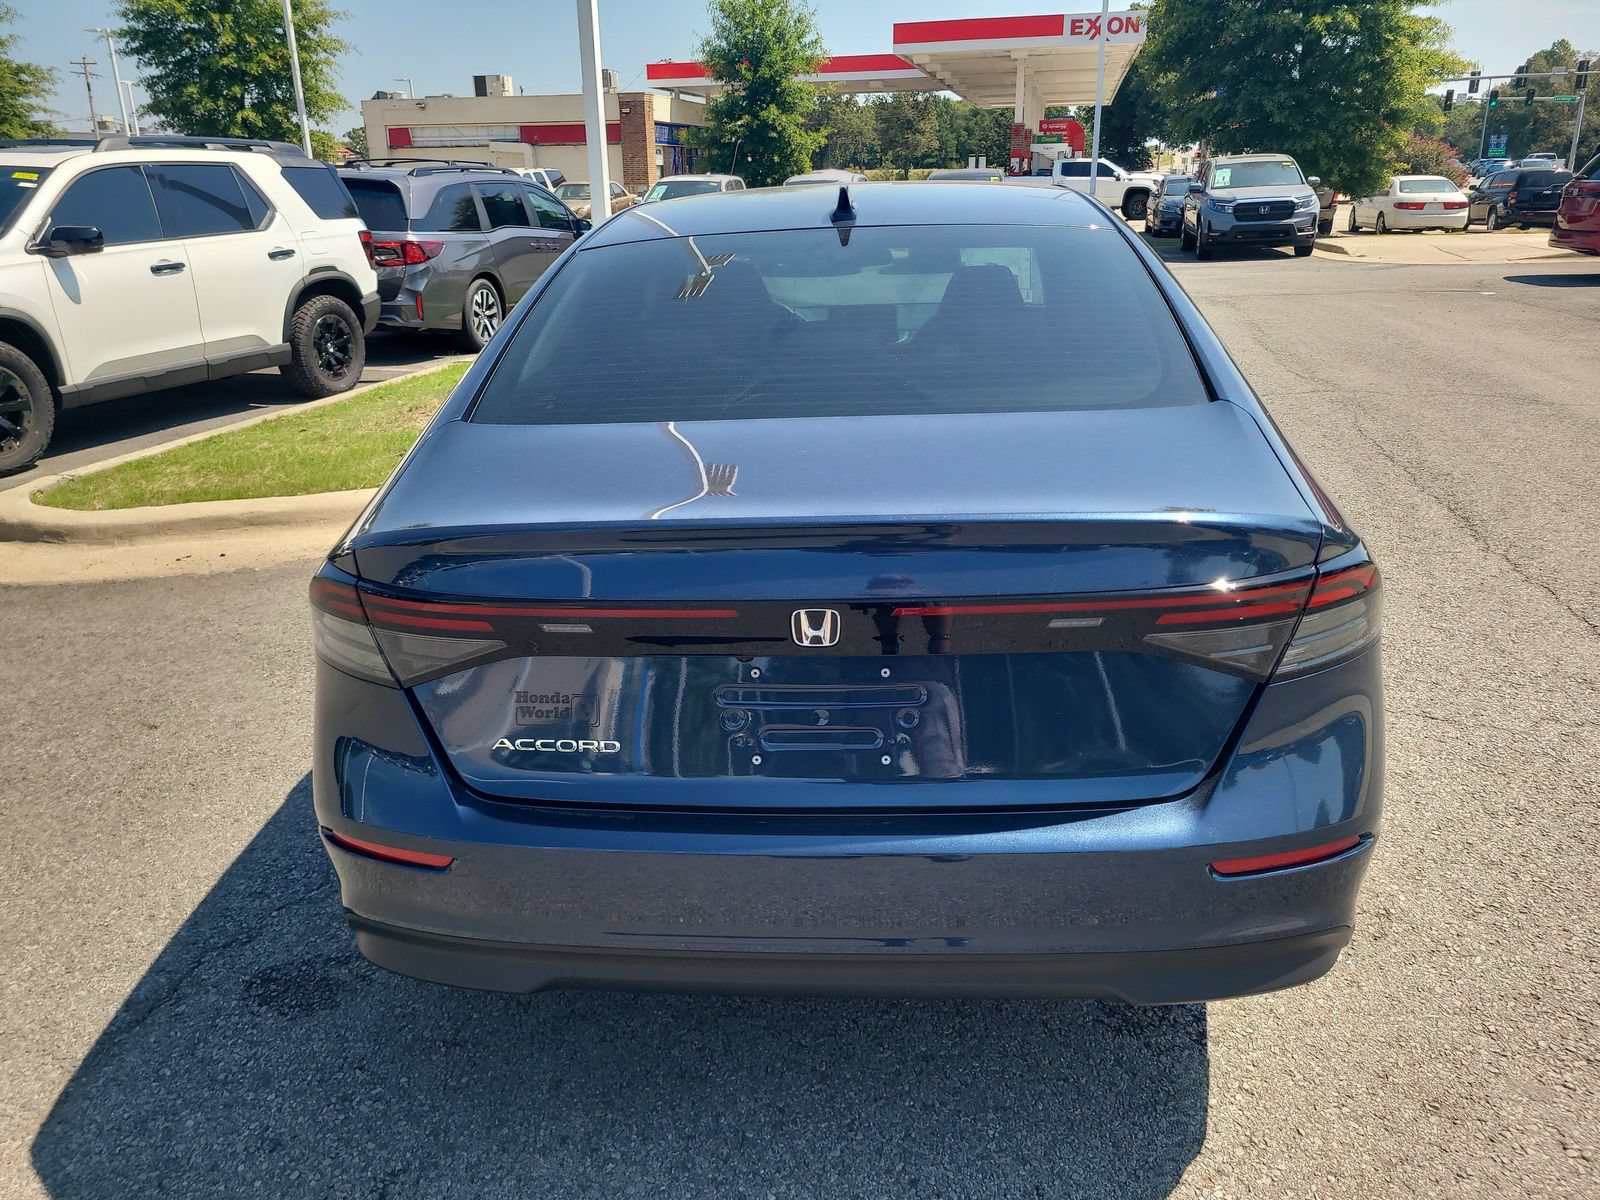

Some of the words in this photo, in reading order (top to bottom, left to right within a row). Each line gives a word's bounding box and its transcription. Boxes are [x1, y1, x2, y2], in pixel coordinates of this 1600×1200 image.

[515, 691, 570, 704] Honda
[519, 706, 570, 719] World
[492, 738, 621, 753] ACCORD
